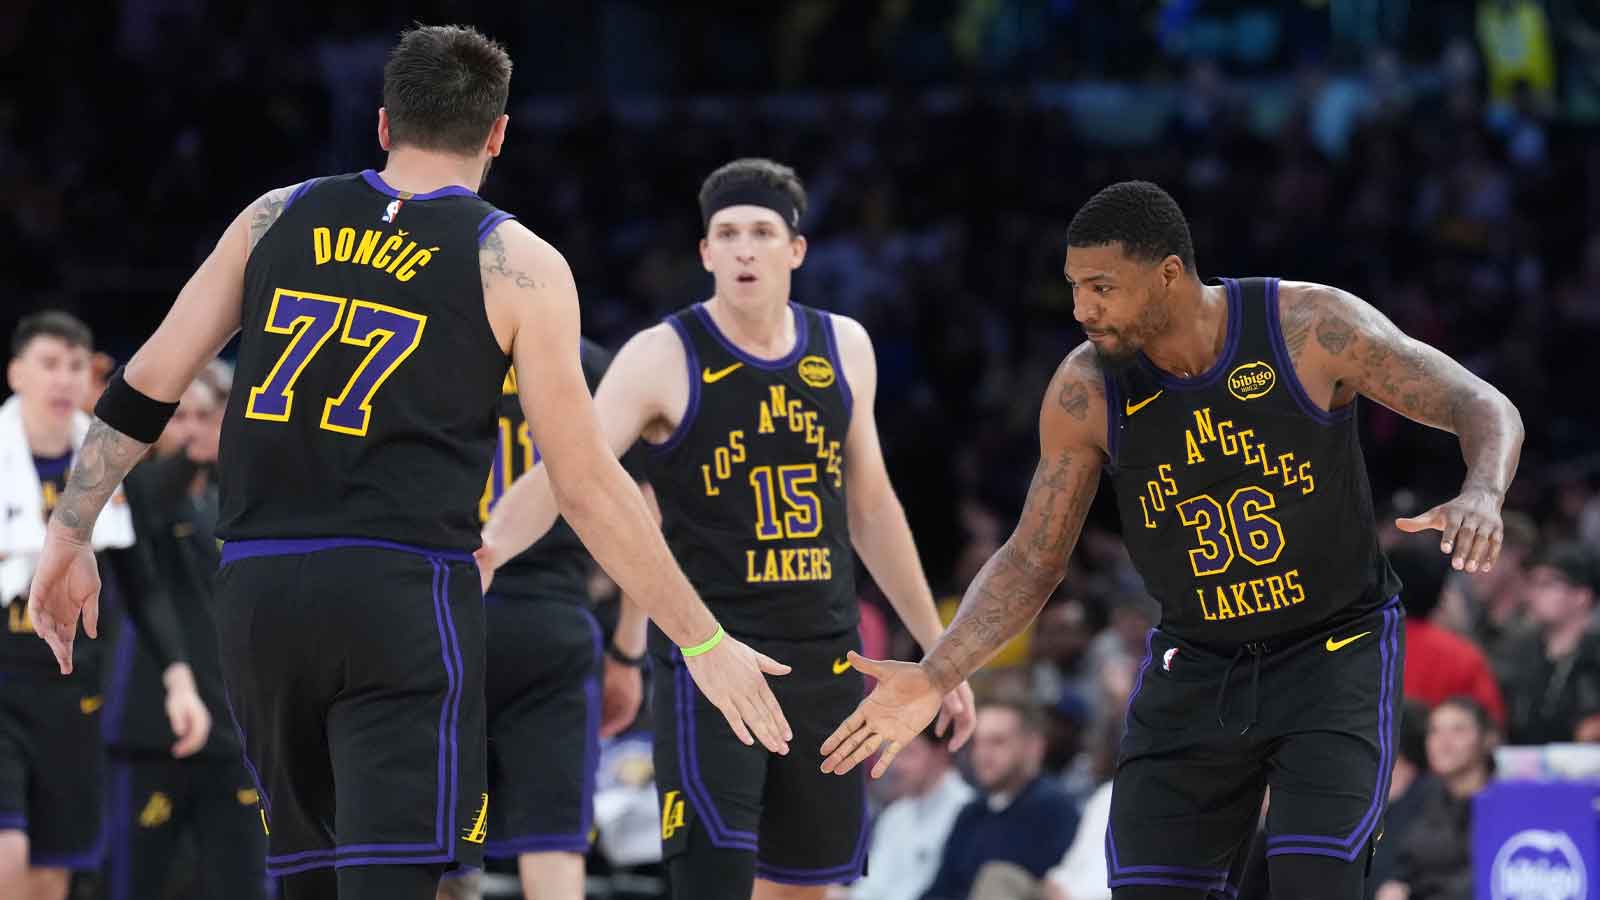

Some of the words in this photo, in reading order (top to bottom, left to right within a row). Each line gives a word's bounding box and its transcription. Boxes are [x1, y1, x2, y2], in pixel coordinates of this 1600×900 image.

[312, 226, 441, 282] DONČIĆ
[245, 287, 428, 437] 77
[1231, 371, 1272, 389] bibigo
[701, 430, 746, 496] LOS
[758, 384, 842, 487] ANGELES
[1139, 463, 1179, 529] LOS
[1185, 407, 1315, 496] ANGELES
[748, 463, 823, 541] 15
[1175, 485, 1286, 577] 36
[746, 547, 832, 583] LAKERS
[1196, 569, 1306, 621] LAKERS
